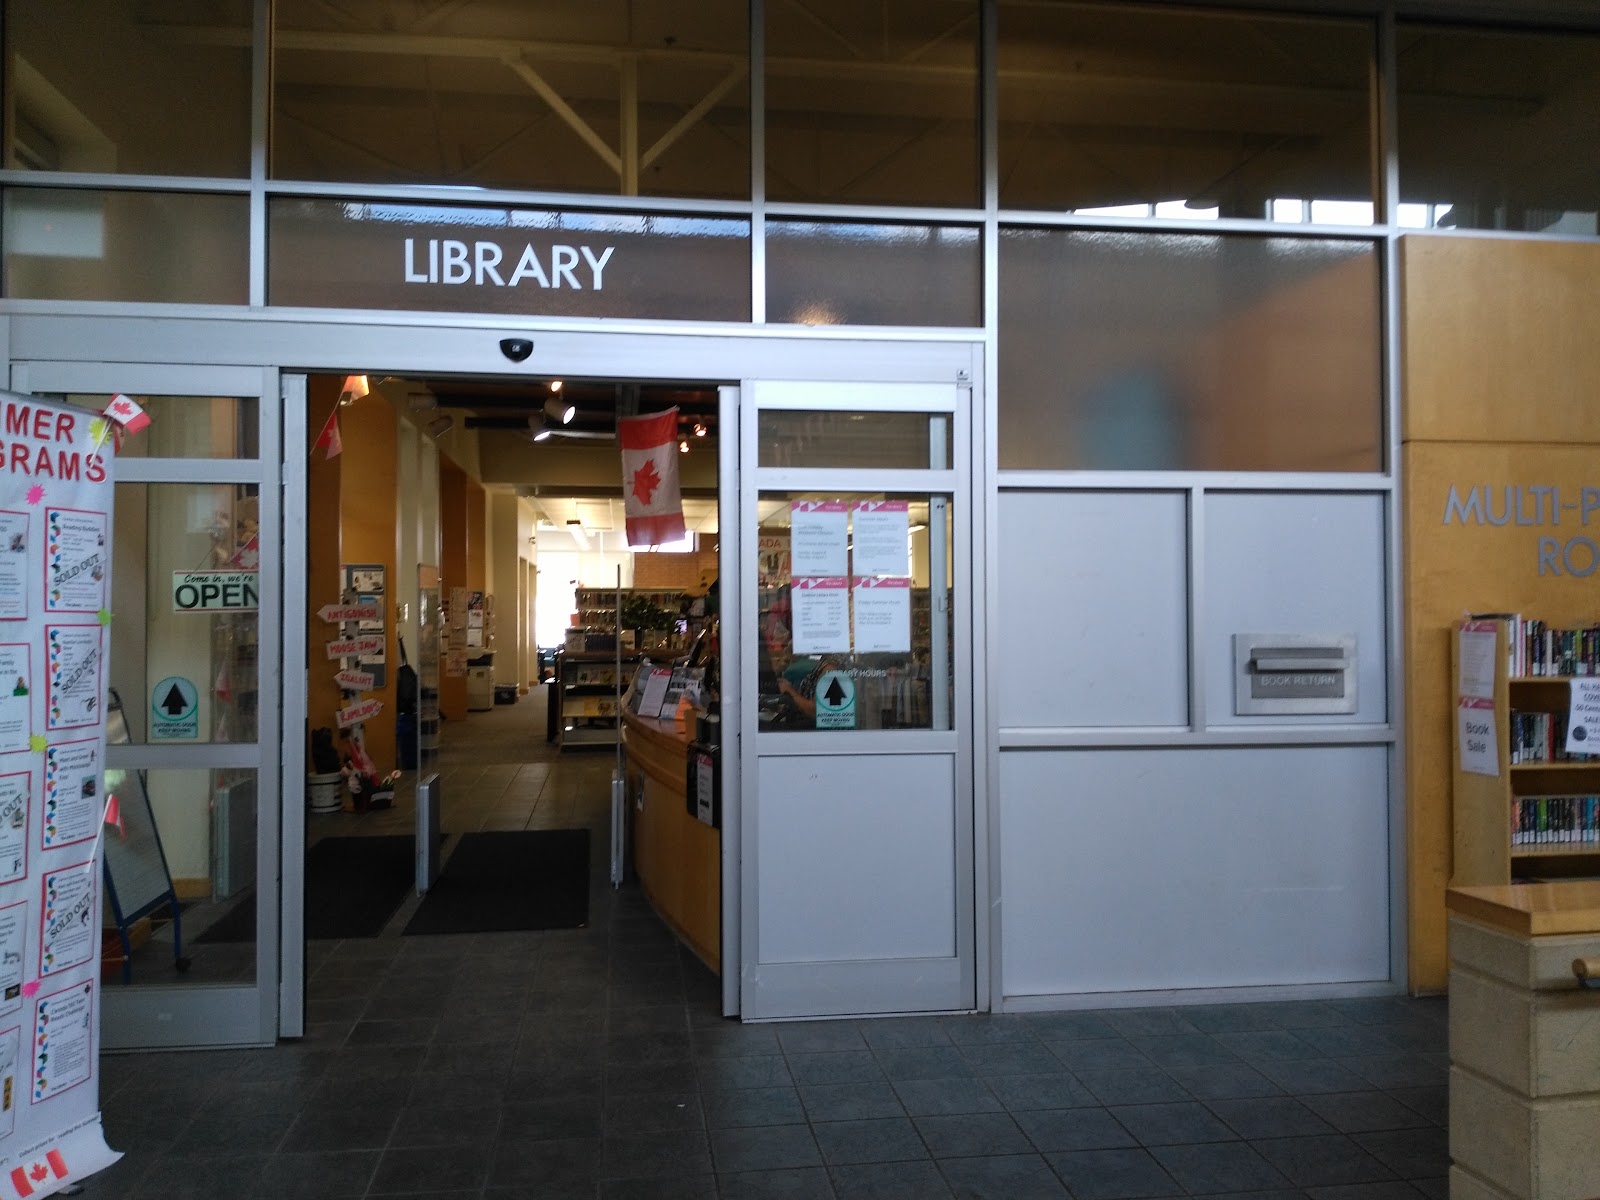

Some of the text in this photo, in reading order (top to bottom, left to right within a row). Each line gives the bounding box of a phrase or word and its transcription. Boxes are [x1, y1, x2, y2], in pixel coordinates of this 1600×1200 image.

[404, 238, 616, 290] LIBRARY
[0, 403, 76, 444] MER
[1443, 484, 1600, 526] MULTI-P
[54, 553, 100, 587] SOLD OUT
[1538, 536, 1600, 577] RO
[184, 574, 209, 583] Come
[175, 584, 258, 609] OPEN
[61, 667, 83, 695] SOLD
[82, 648, 98, 671] OUT
[860, 669, 887, 678] HOURS
[1261, 675, 1336, 686] BOOK RETURN
[1466, 721, 1490, 737] Book
[1467, 739, 1487, 754] Sale
[3, 793, 23, 818] OUT
[50, 912, 73, 939] SOLD
[73, 892, 92, 914] OUT
